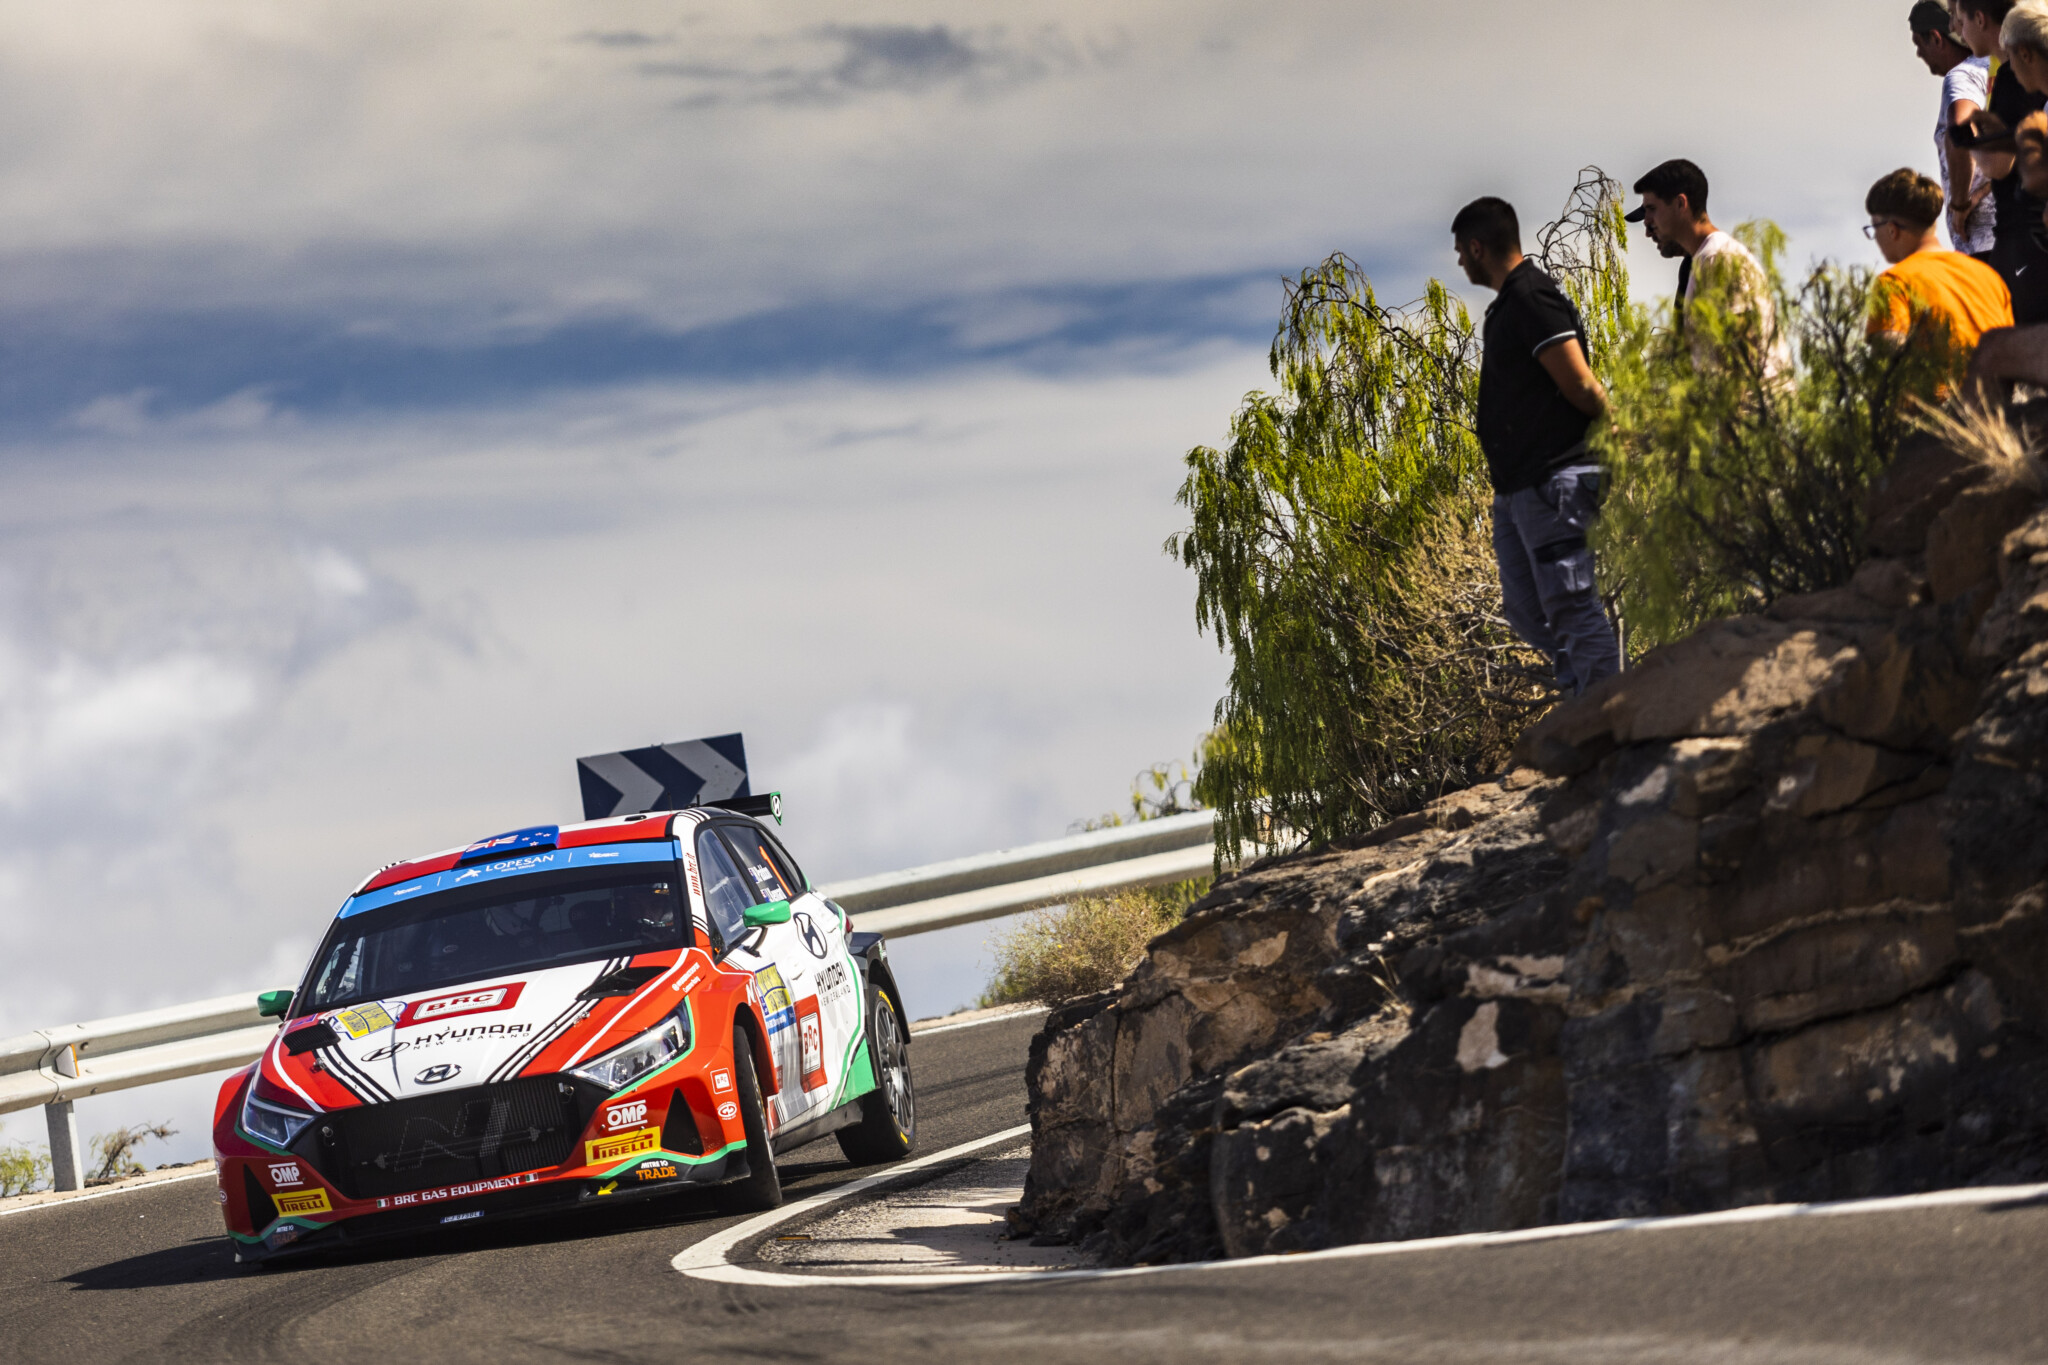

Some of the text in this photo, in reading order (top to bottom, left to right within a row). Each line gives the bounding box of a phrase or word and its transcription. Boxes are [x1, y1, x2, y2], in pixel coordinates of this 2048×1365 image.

[486, 855, 554, 871] LOPESAN
[814, 961, 847, 995] HYUNDAI
[426, 994, 494, 1011] BRC
[413, 1033, 530, 1050] NEW ZEALAND
[415, 1024, 532, 1045] HYUNDAI
[804, 1024, 818, 1055] BRC
[606, 1104, 648, 1126] OMP
[592, 1133, 654, 1160] PIRELLI
[271, 1166, 300, 1183] OMP
[636, 1166, 678, 1181] TRADE
[641, 1161, 659, 1169] MITRE
[394, 1176, 521, 1205] BRC GAS EQUIPMENT
[277, 1193, 325, 1213] PIRELLI
